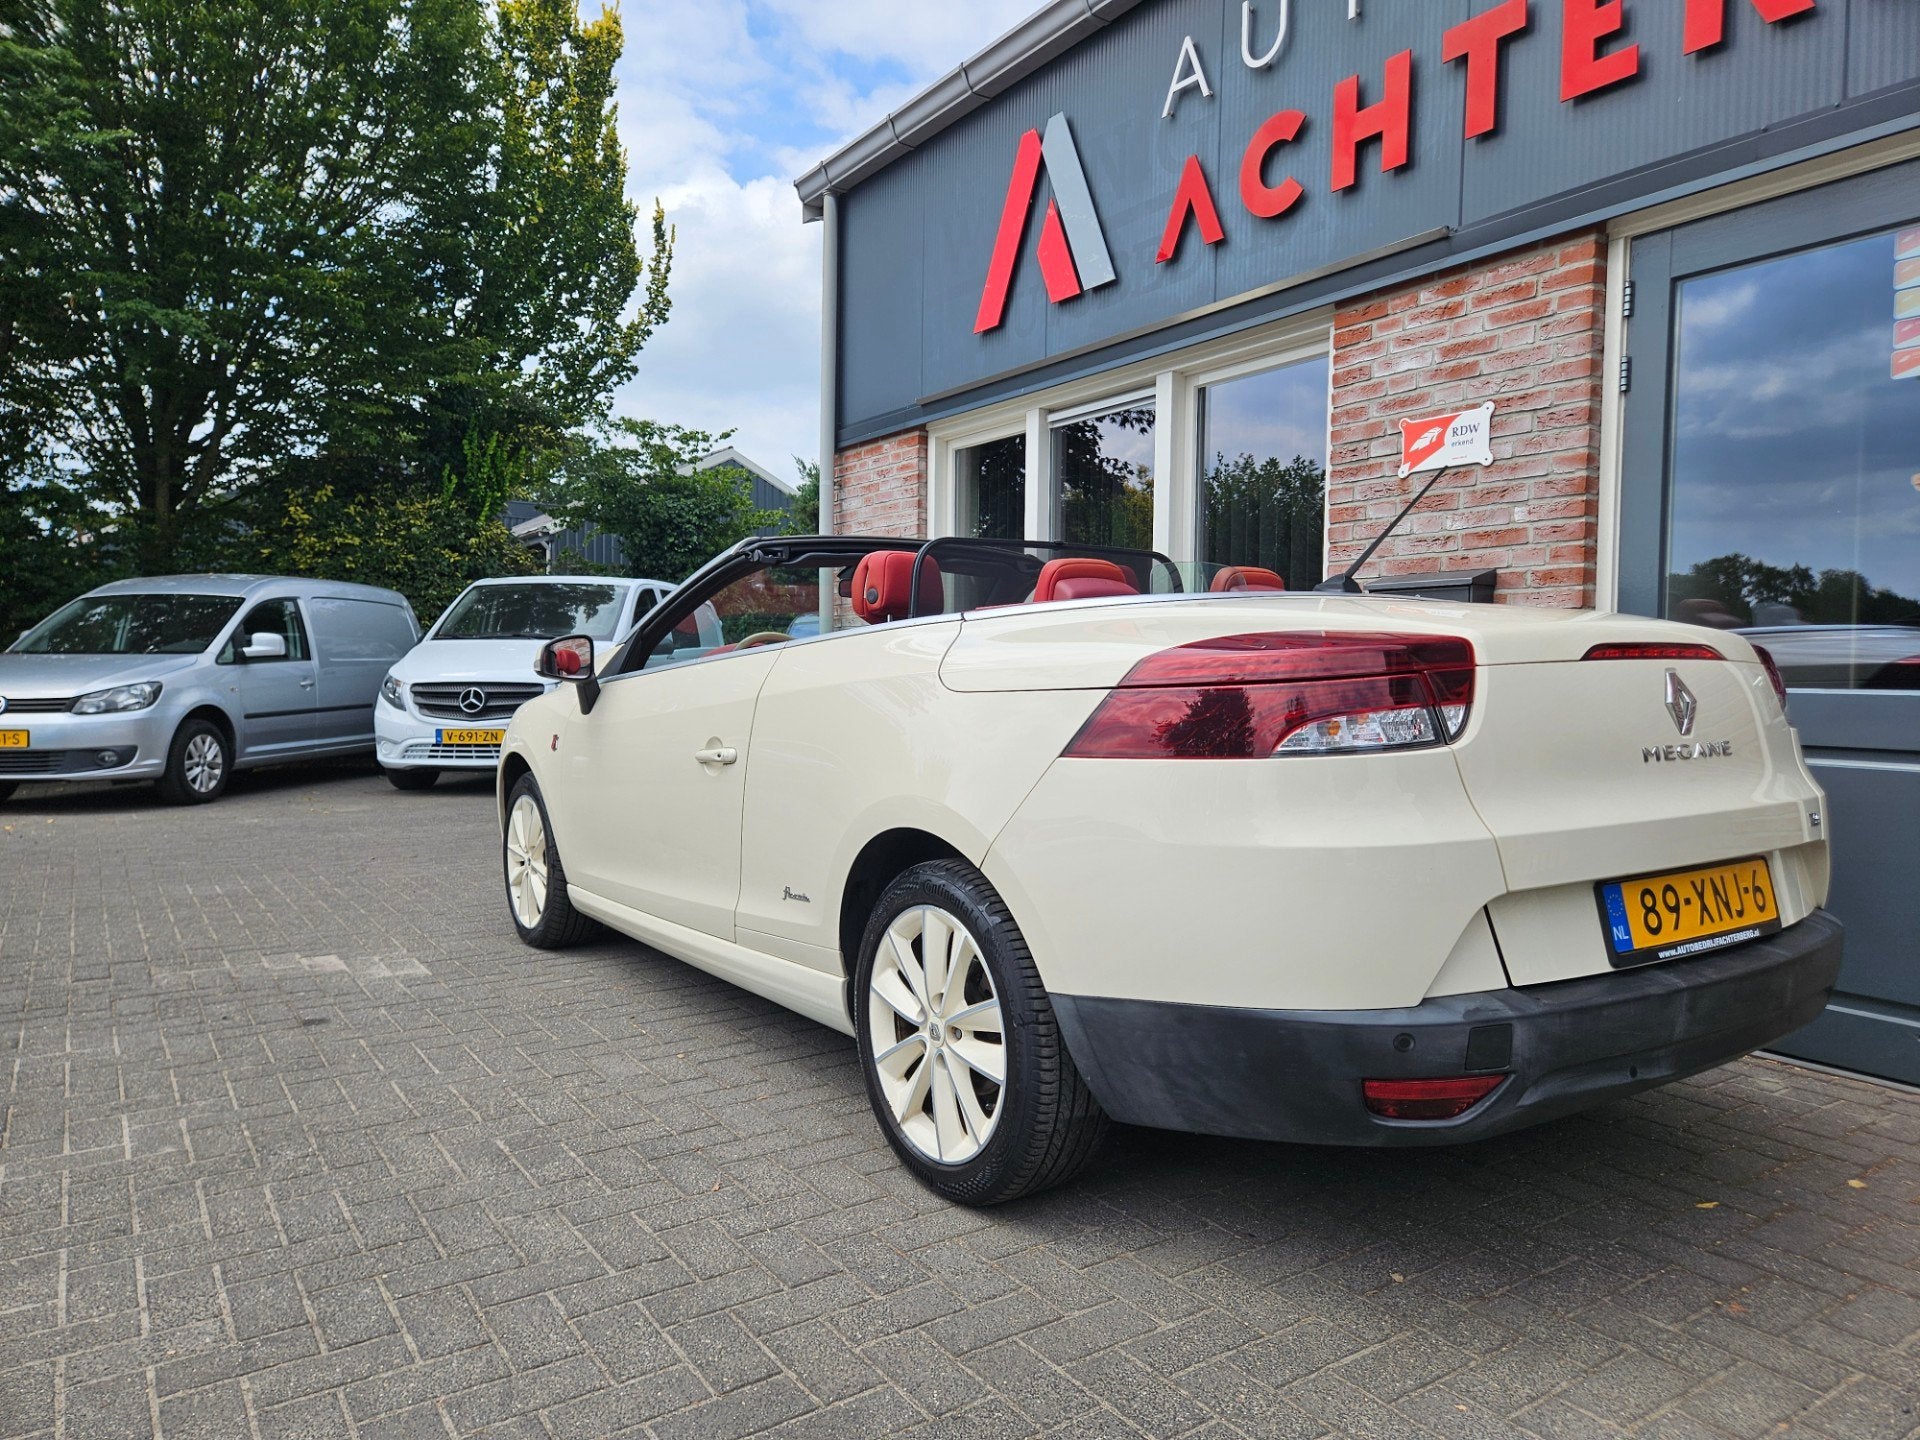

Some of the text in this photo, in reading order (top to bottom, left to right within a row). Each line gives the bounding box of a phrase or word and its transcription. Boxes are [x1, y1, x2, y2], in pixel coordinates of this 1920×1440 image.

[1160, 0, 1358, 119] AU
[1451, 422, 1481, 438] RDW
[446, 731, 499, 742] V-691-ZN
[1641, 740, 1733, 763] MEGANE
[1639, 868, 1767, 936] 89-XNJ-6
[1612, 926, 1630, 942] NL
